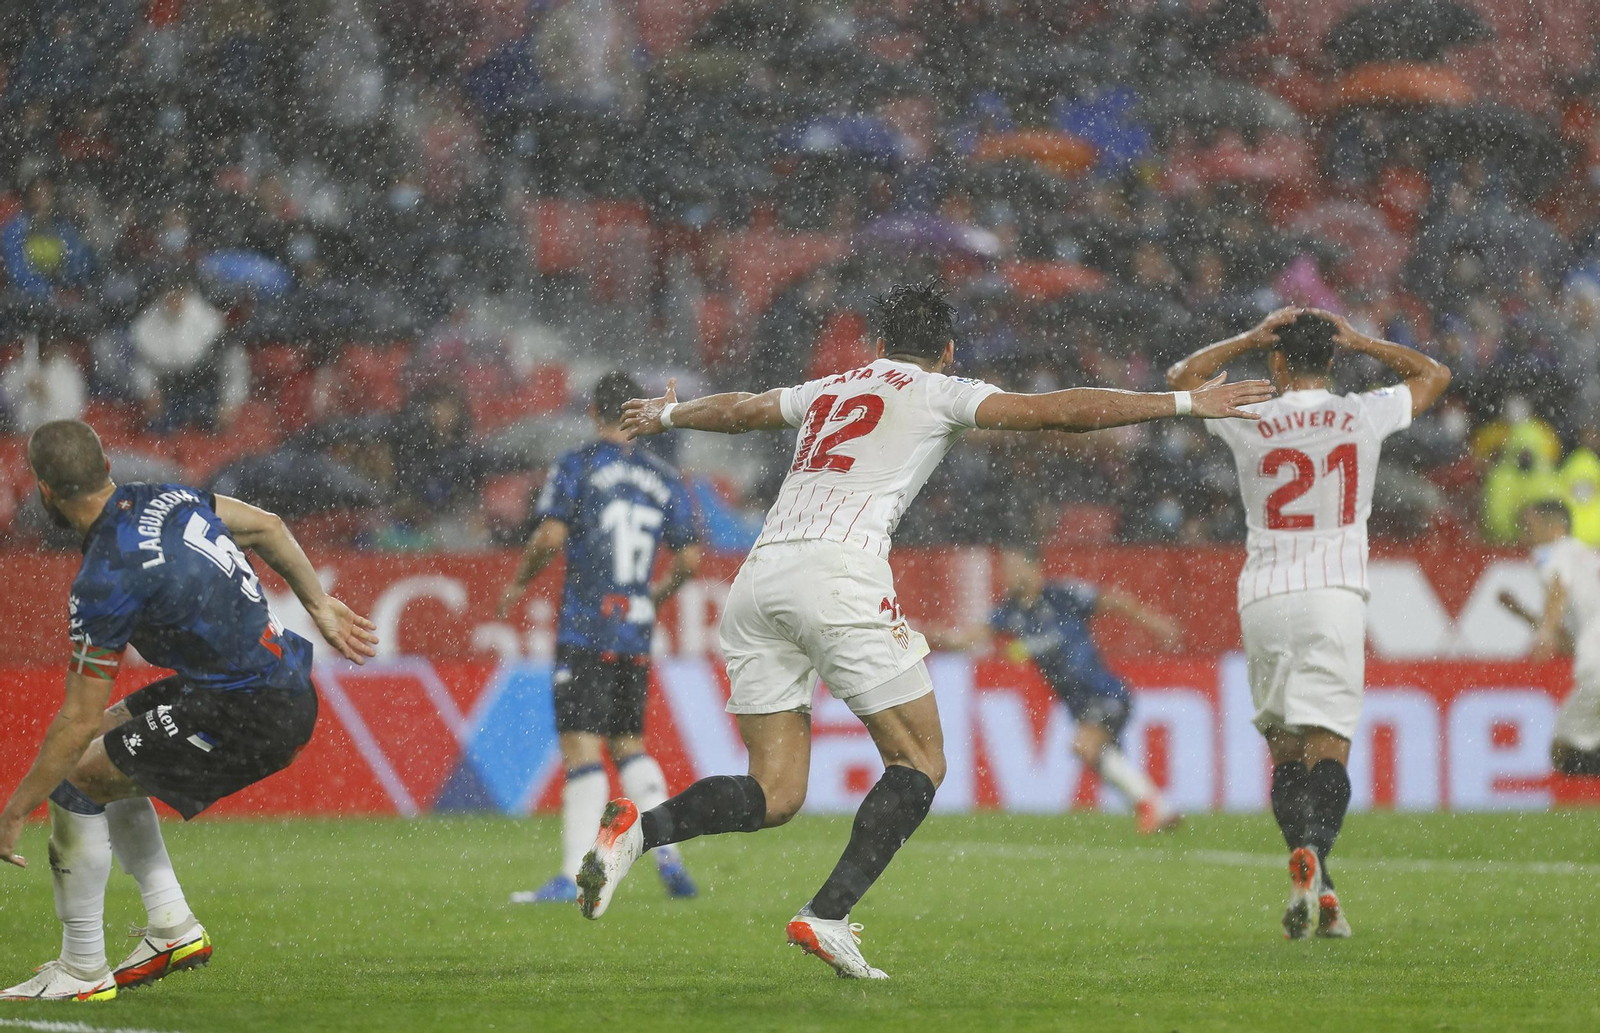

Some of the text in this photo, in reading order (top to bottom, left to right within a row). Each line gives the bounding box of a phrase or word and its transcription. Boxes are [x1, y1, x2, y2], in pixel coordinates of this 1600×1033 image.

[877, 369, 914, 392] MIR
[792, 393, 885, 474] 12
[1257, 410, 1355, 439] OLIVER T.
[1258, 443, 1359, 531] 21
[183, 511, 261, 602] 5
[157, 704, 179, 738] ken
[658, 651, 1557, 812] Valvolne
